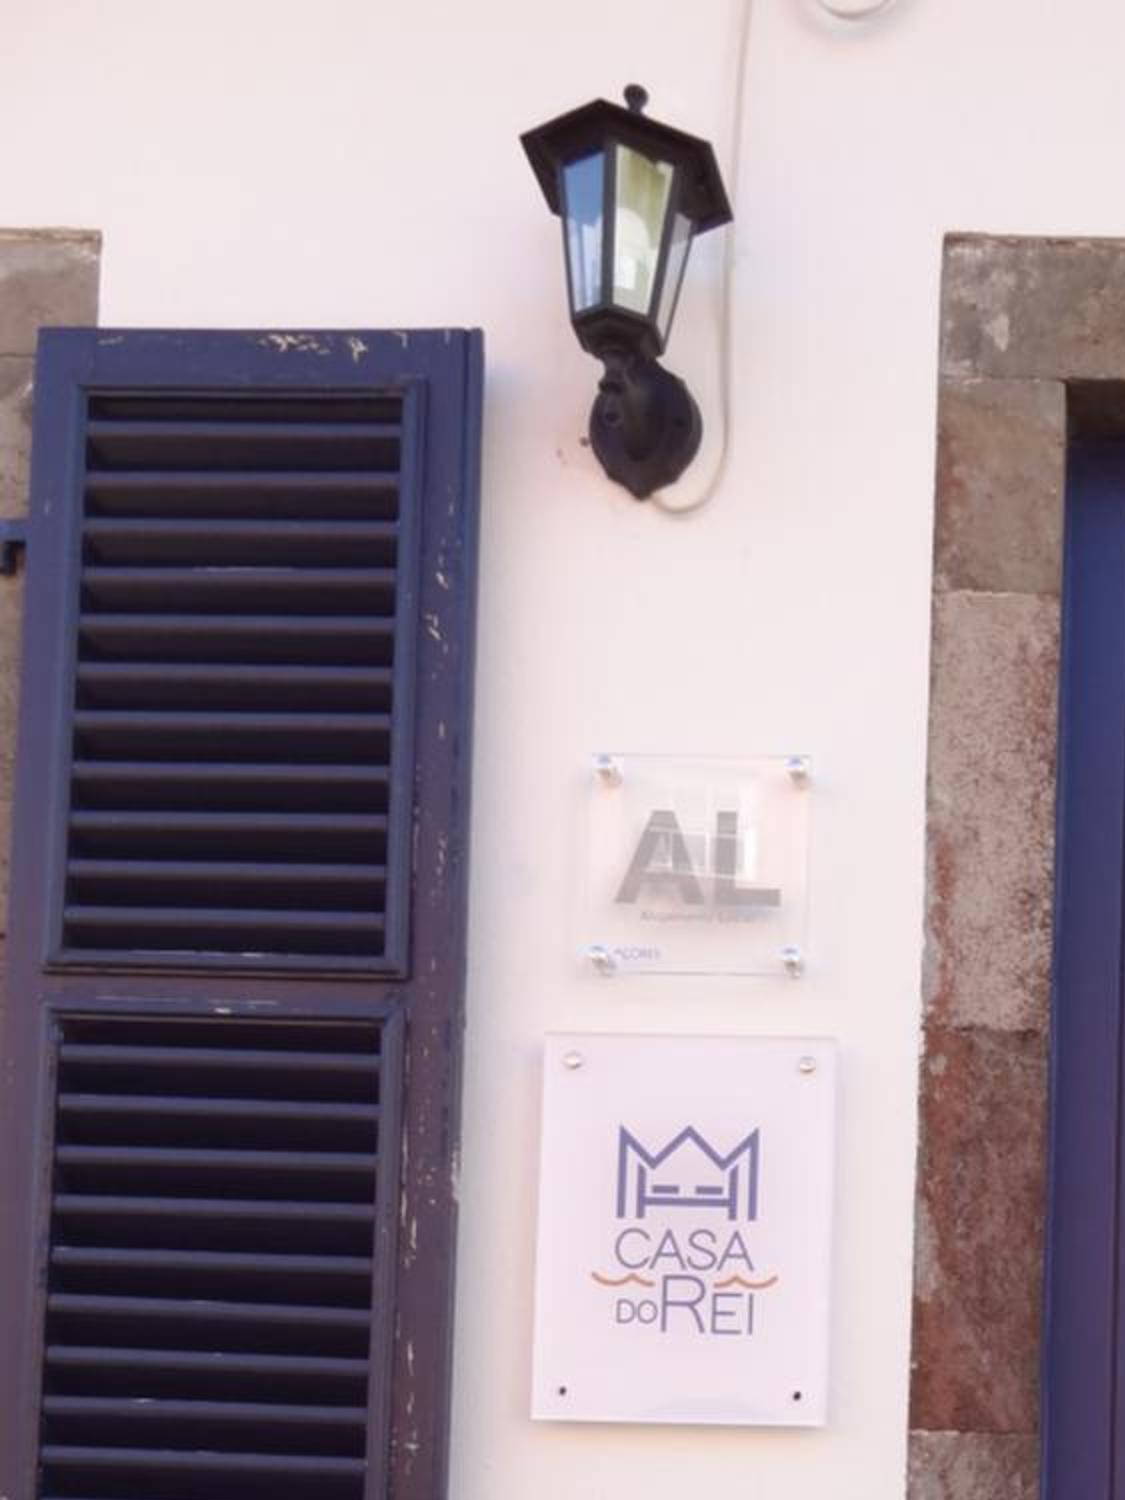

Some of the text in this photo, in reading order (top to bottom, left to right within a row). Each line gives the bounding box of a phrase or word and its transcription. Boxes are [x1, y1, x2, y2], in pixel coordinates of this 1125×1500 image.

[614, 810, 781, 907] AL
[615, 1228, 754, 1272] CASA
[616, 1275, 754, 1335] DO REI
